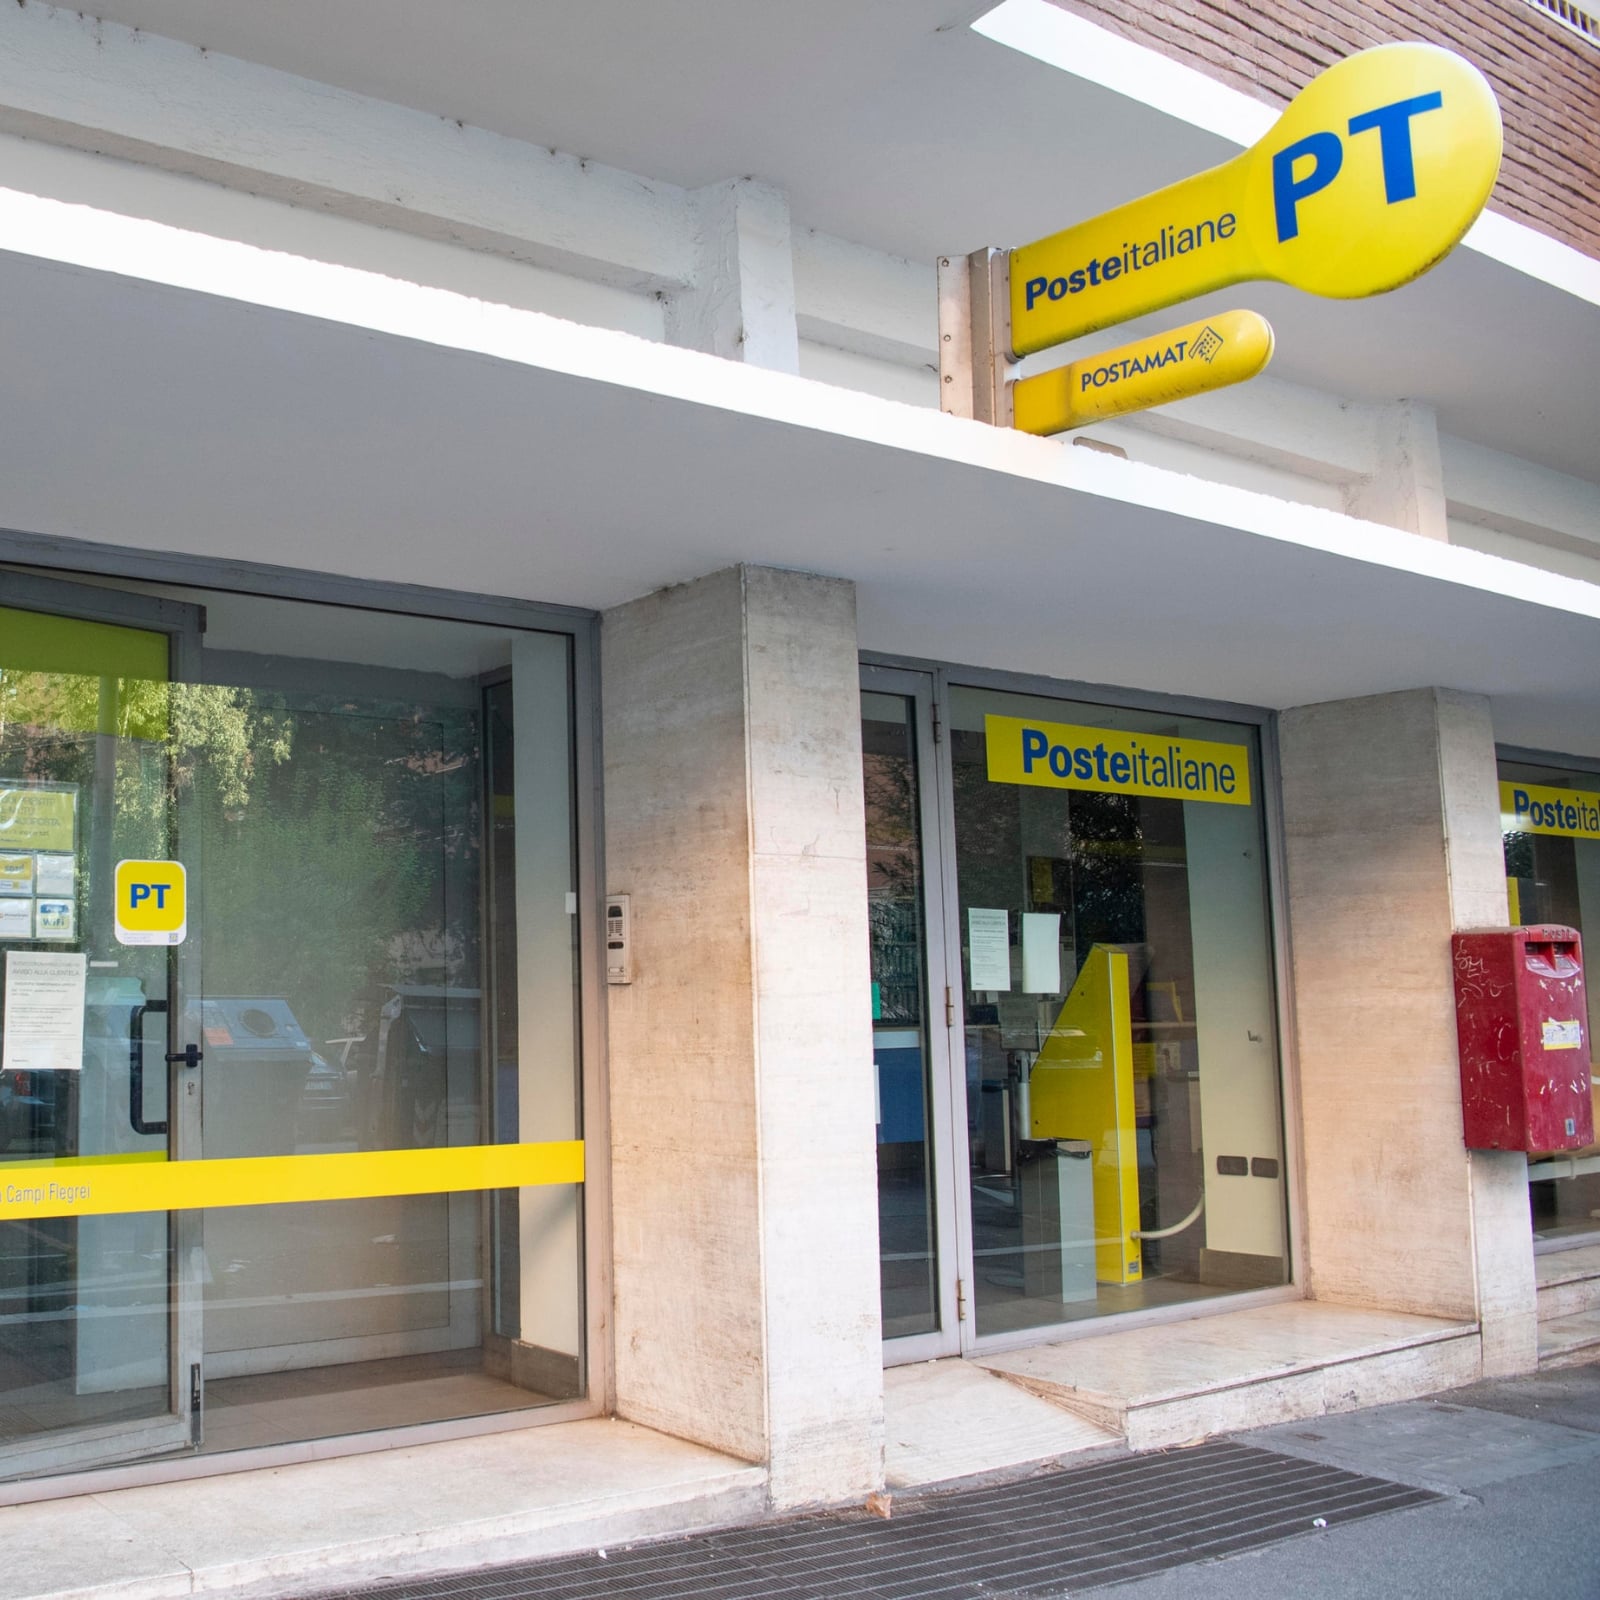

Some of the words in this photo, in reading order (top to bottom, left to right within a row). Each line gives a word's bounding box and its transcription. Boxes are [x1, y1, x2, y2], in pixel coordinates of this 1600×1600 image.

[1272, 90, 1443, 244] PT
[1025, 211, 1237, 311] Posteitaliane
[1081, 341, 1188, 392] POSTAMAT
[1021, 728, 1236, 794] Posteitaliane
[130, 883, 171, 909] PT
[6, 1184, 45, 1205] Campi
[49, 1181, 91, 1204] Flegrei
